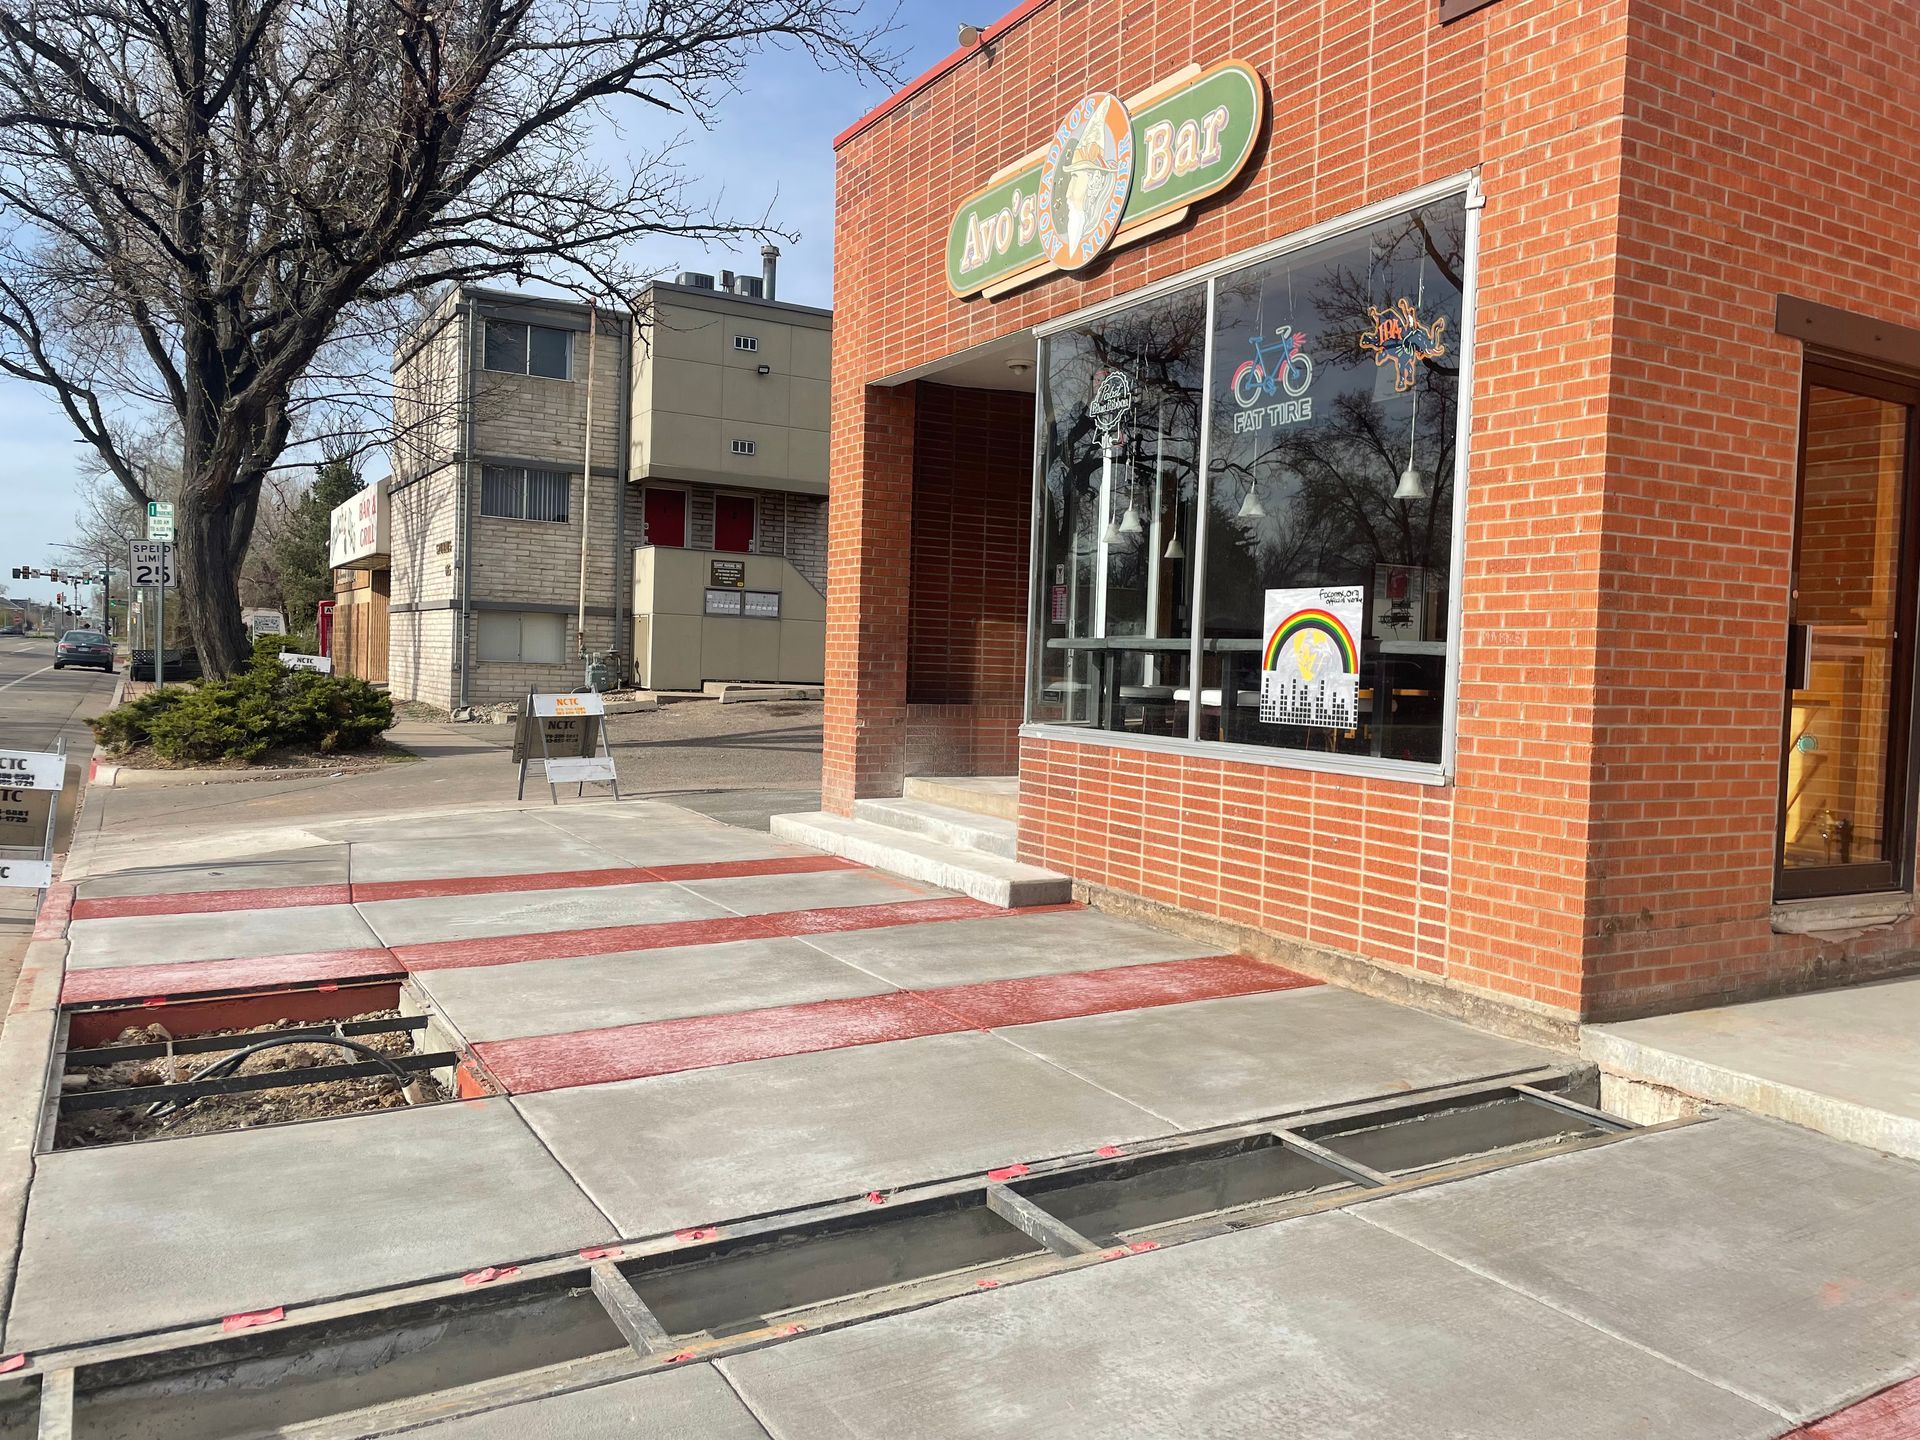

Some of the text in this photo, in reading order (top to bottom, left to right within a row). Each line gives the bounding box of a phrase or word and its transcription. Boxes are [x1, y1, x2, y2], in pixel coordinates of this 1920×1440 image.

[959, 104, 1229, 274] Avo's Bar
[1039, 98, 1131, 261] AVOGADRO'S NUMBER
[1378, 319, 1402, 346] IPA
[1234, 397, 1312, 434] FAT TIRE
[556, 698, 579, 706] NCTC
[548, 720, 576, 730] NCTC
